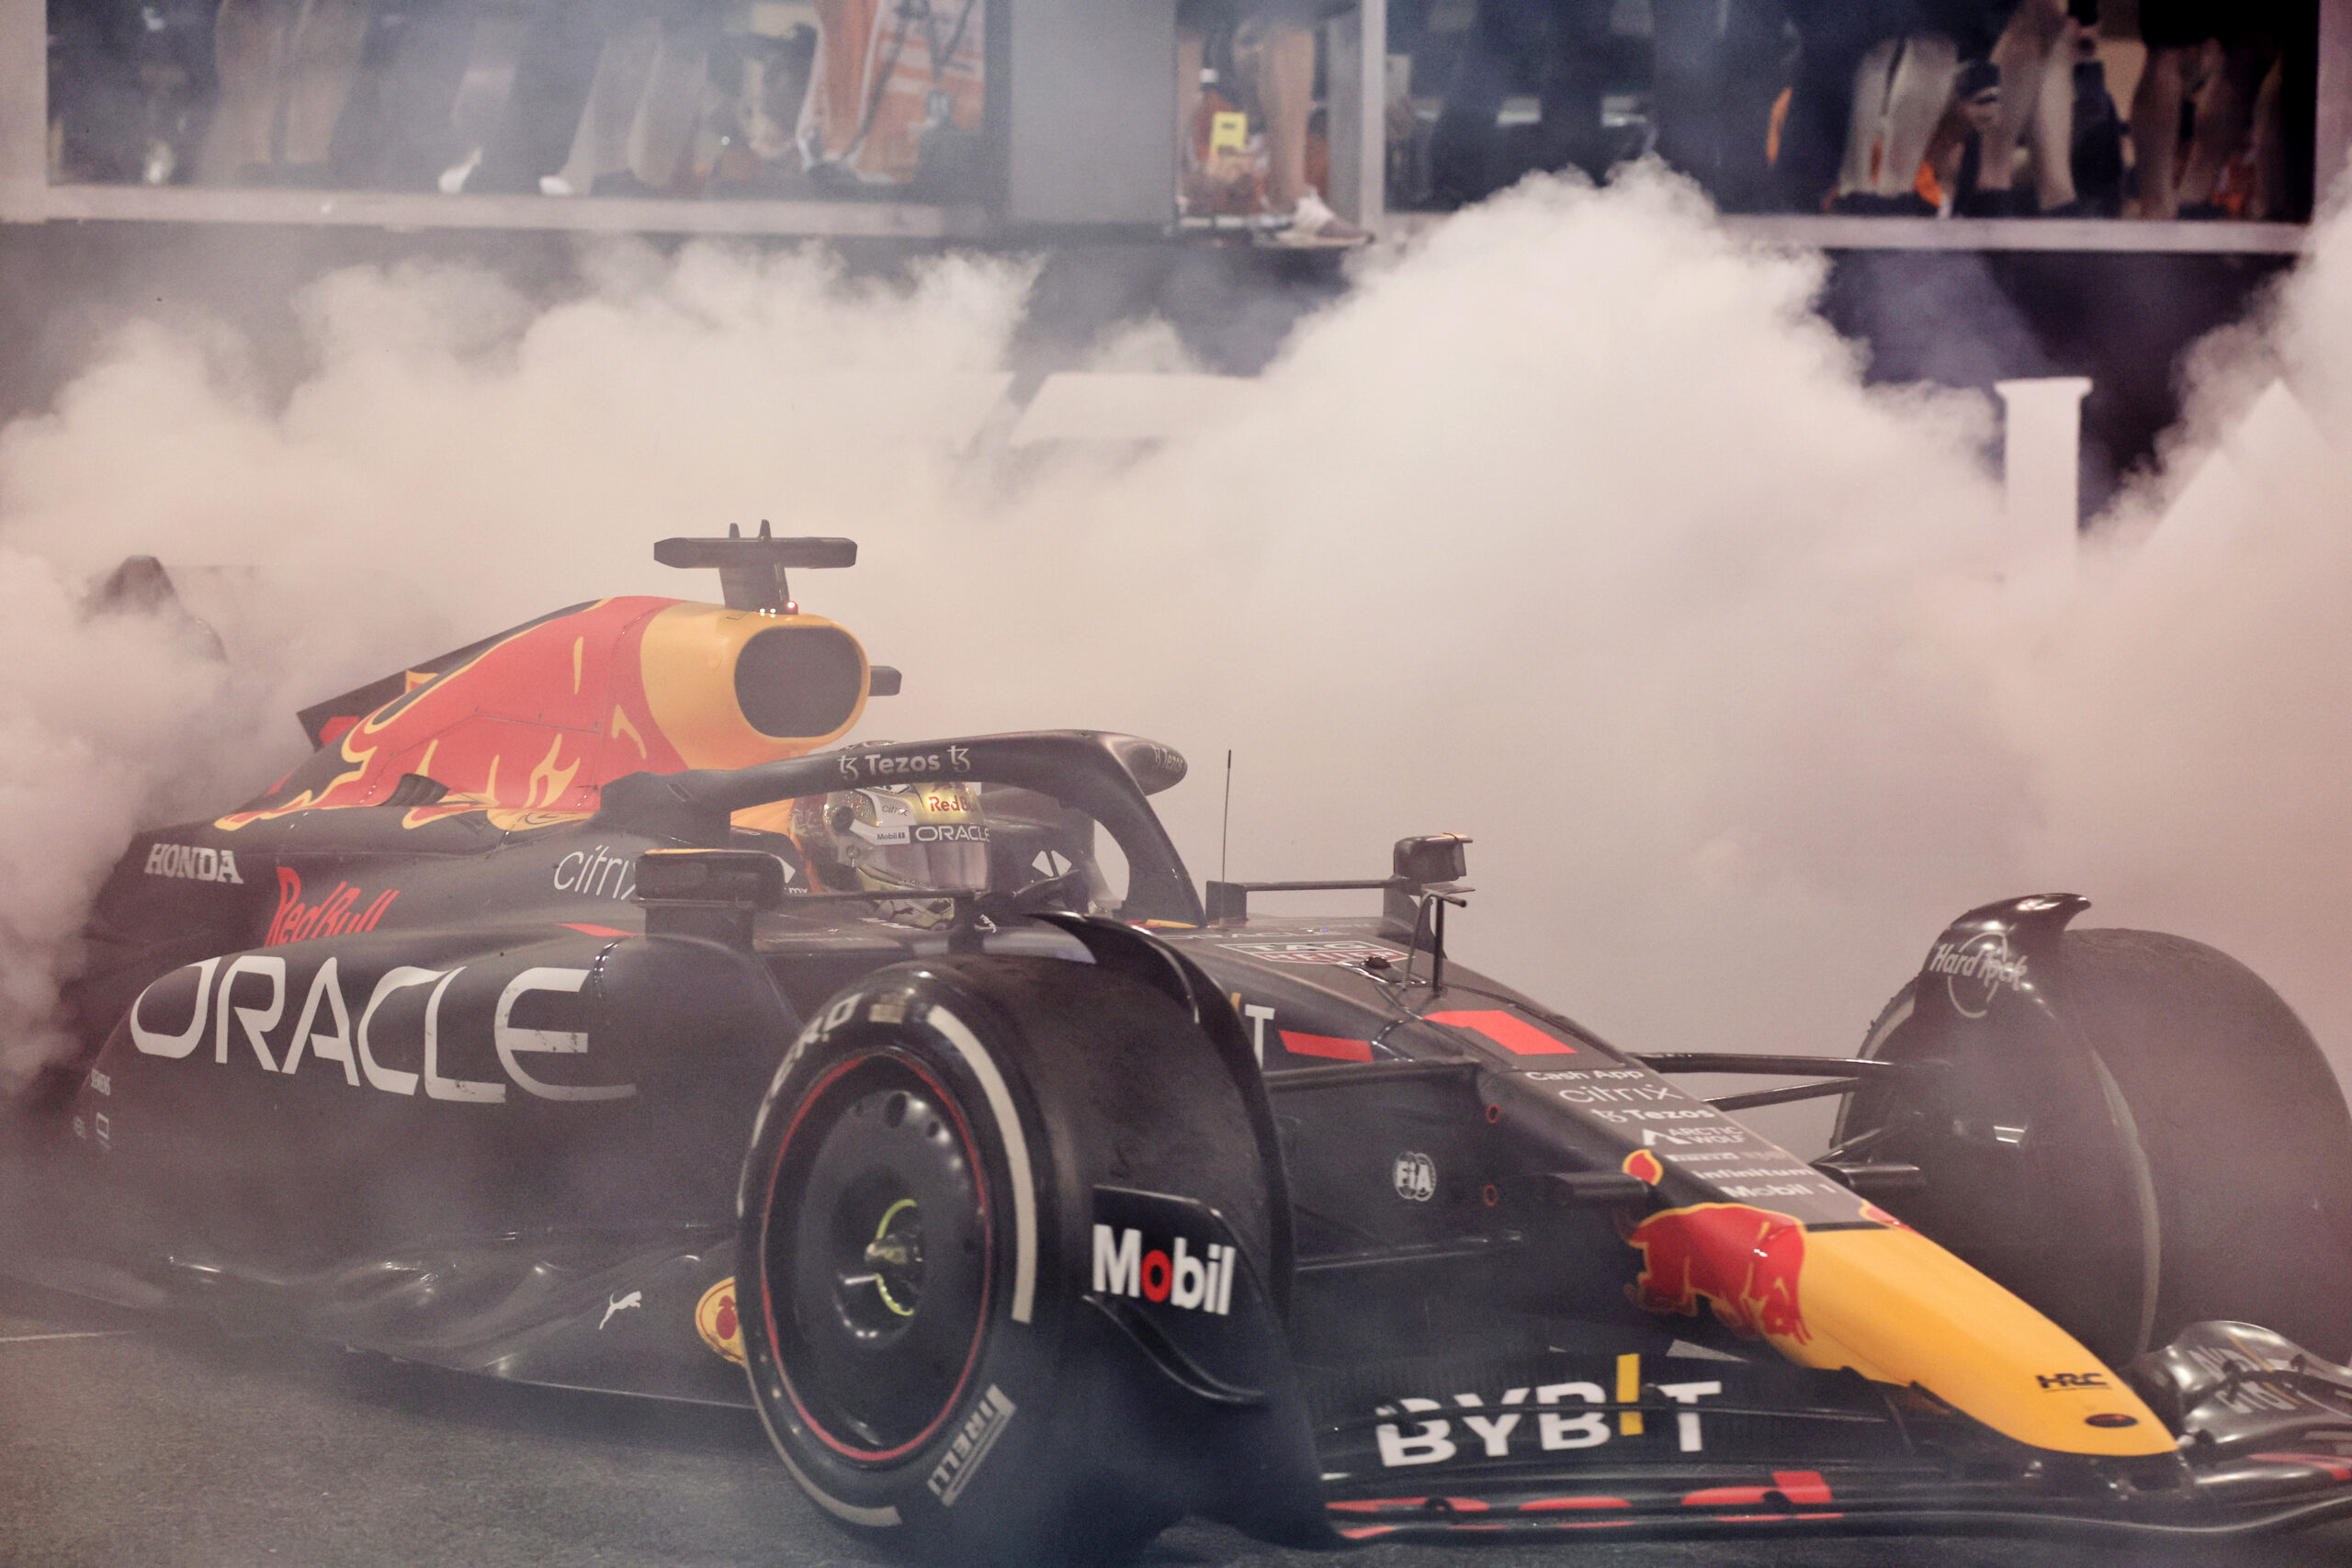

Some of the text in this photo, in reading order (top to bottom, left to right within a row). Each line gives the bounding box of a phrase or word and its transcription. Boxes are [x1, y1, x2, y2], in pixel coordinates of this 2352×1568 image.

[865, 753, 942, 775] Tezos
[876, 832, 898, 840] Mobil
[915, 825, 990, 843] ORACLE
[144, 842, 244, 885] HONDA
[1239, 942, 1369, 952] TAG
[1929, 943, 1986, 977] Hard
[130, 956, 637, 1102] ORACLE
[1525, 1070, 1645, 1081] Cash App
[1623, 1109, 1715, 1120] Tezos
[1668, 1126, 1744, 1136] ARCTIC
[1688, 1135, 1746, 1145] WOLF
[1395, 1159, 1435, 1195] FIA
[1720, 1183, 1837, 1198] Mobil 1
[1093, 1224, 1236, 1315] Mobil
[2035, 1372, 2109, 1389] HRC
[926, 1384, 1016, 1506] PIRELLI
